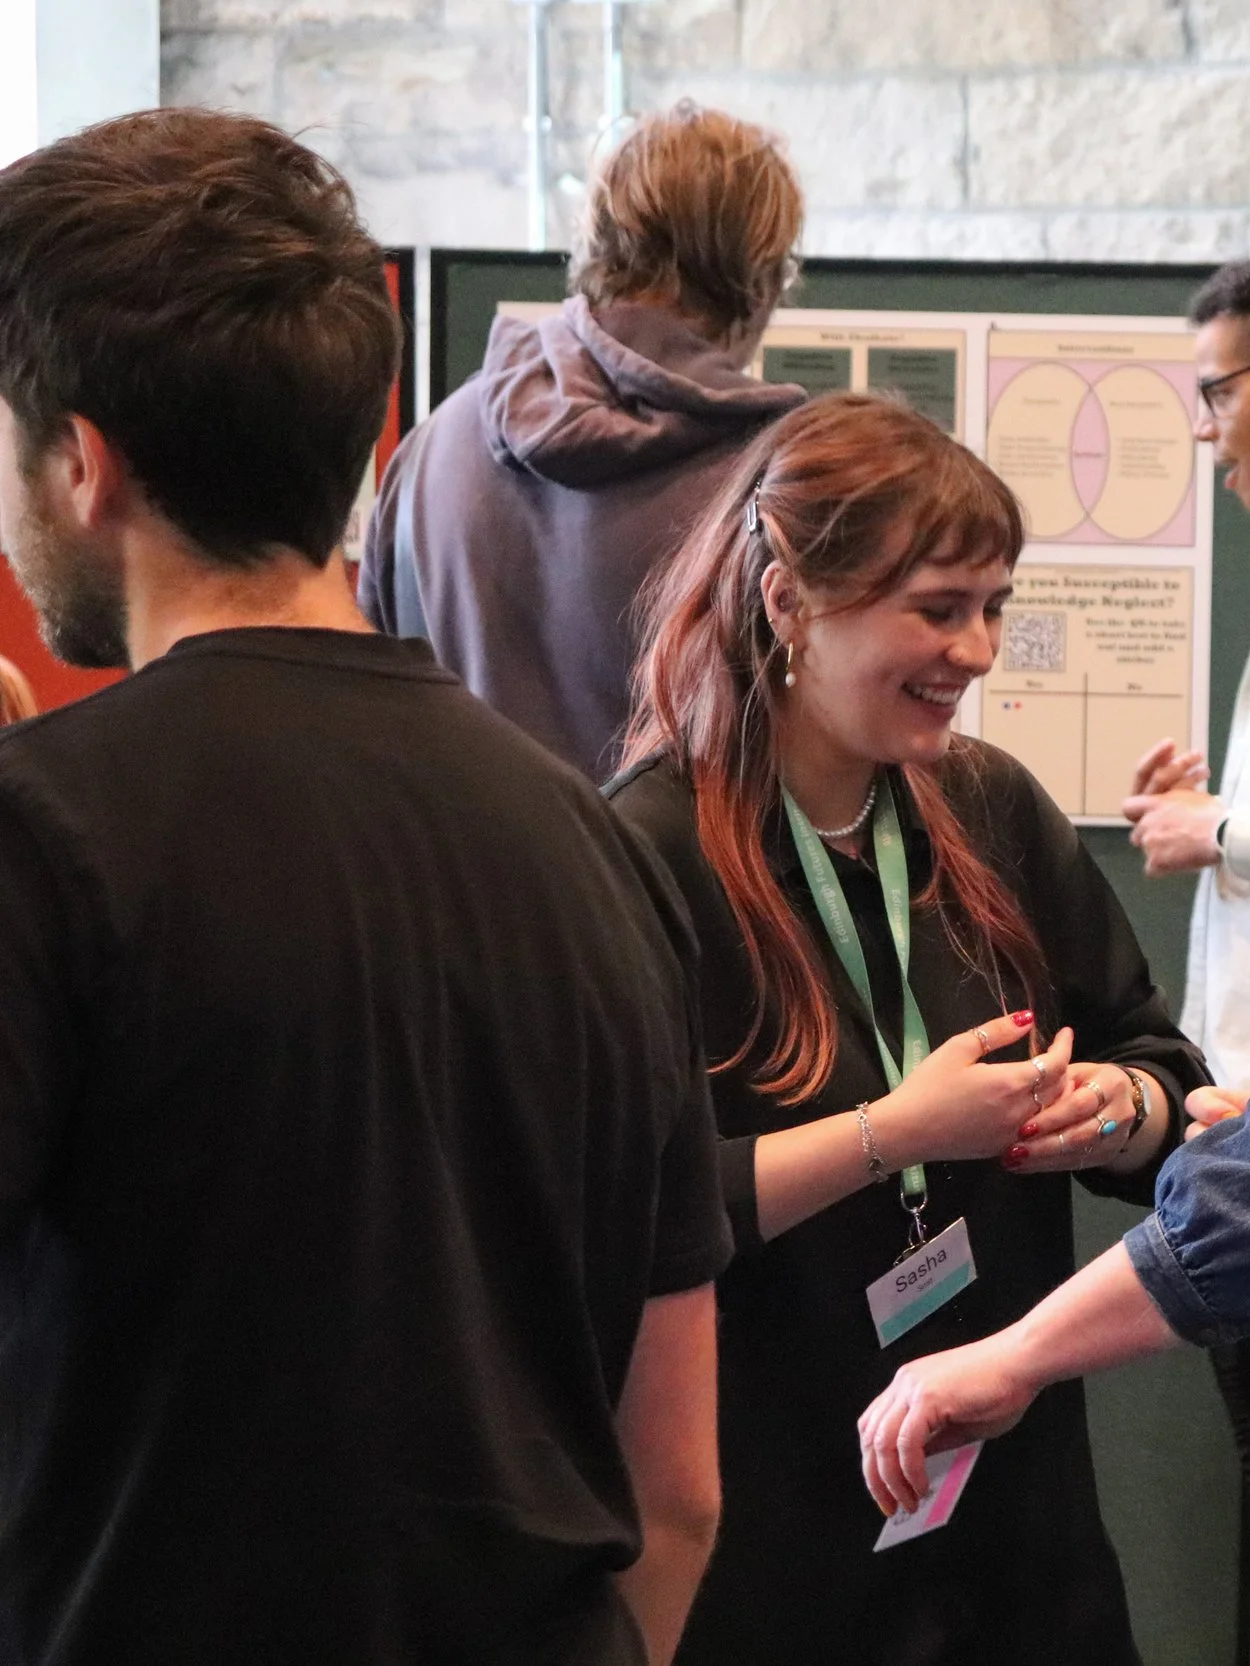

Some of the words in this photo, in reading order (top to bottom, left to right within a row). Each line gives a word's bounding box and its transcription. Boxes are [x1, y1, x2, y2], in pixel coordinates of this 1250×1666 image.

[1063, 576, 1159, 591] Susceptible
[1102, 596, 1175, 611] Neglect?
[895, 1248, 947, 1293] Sasha
